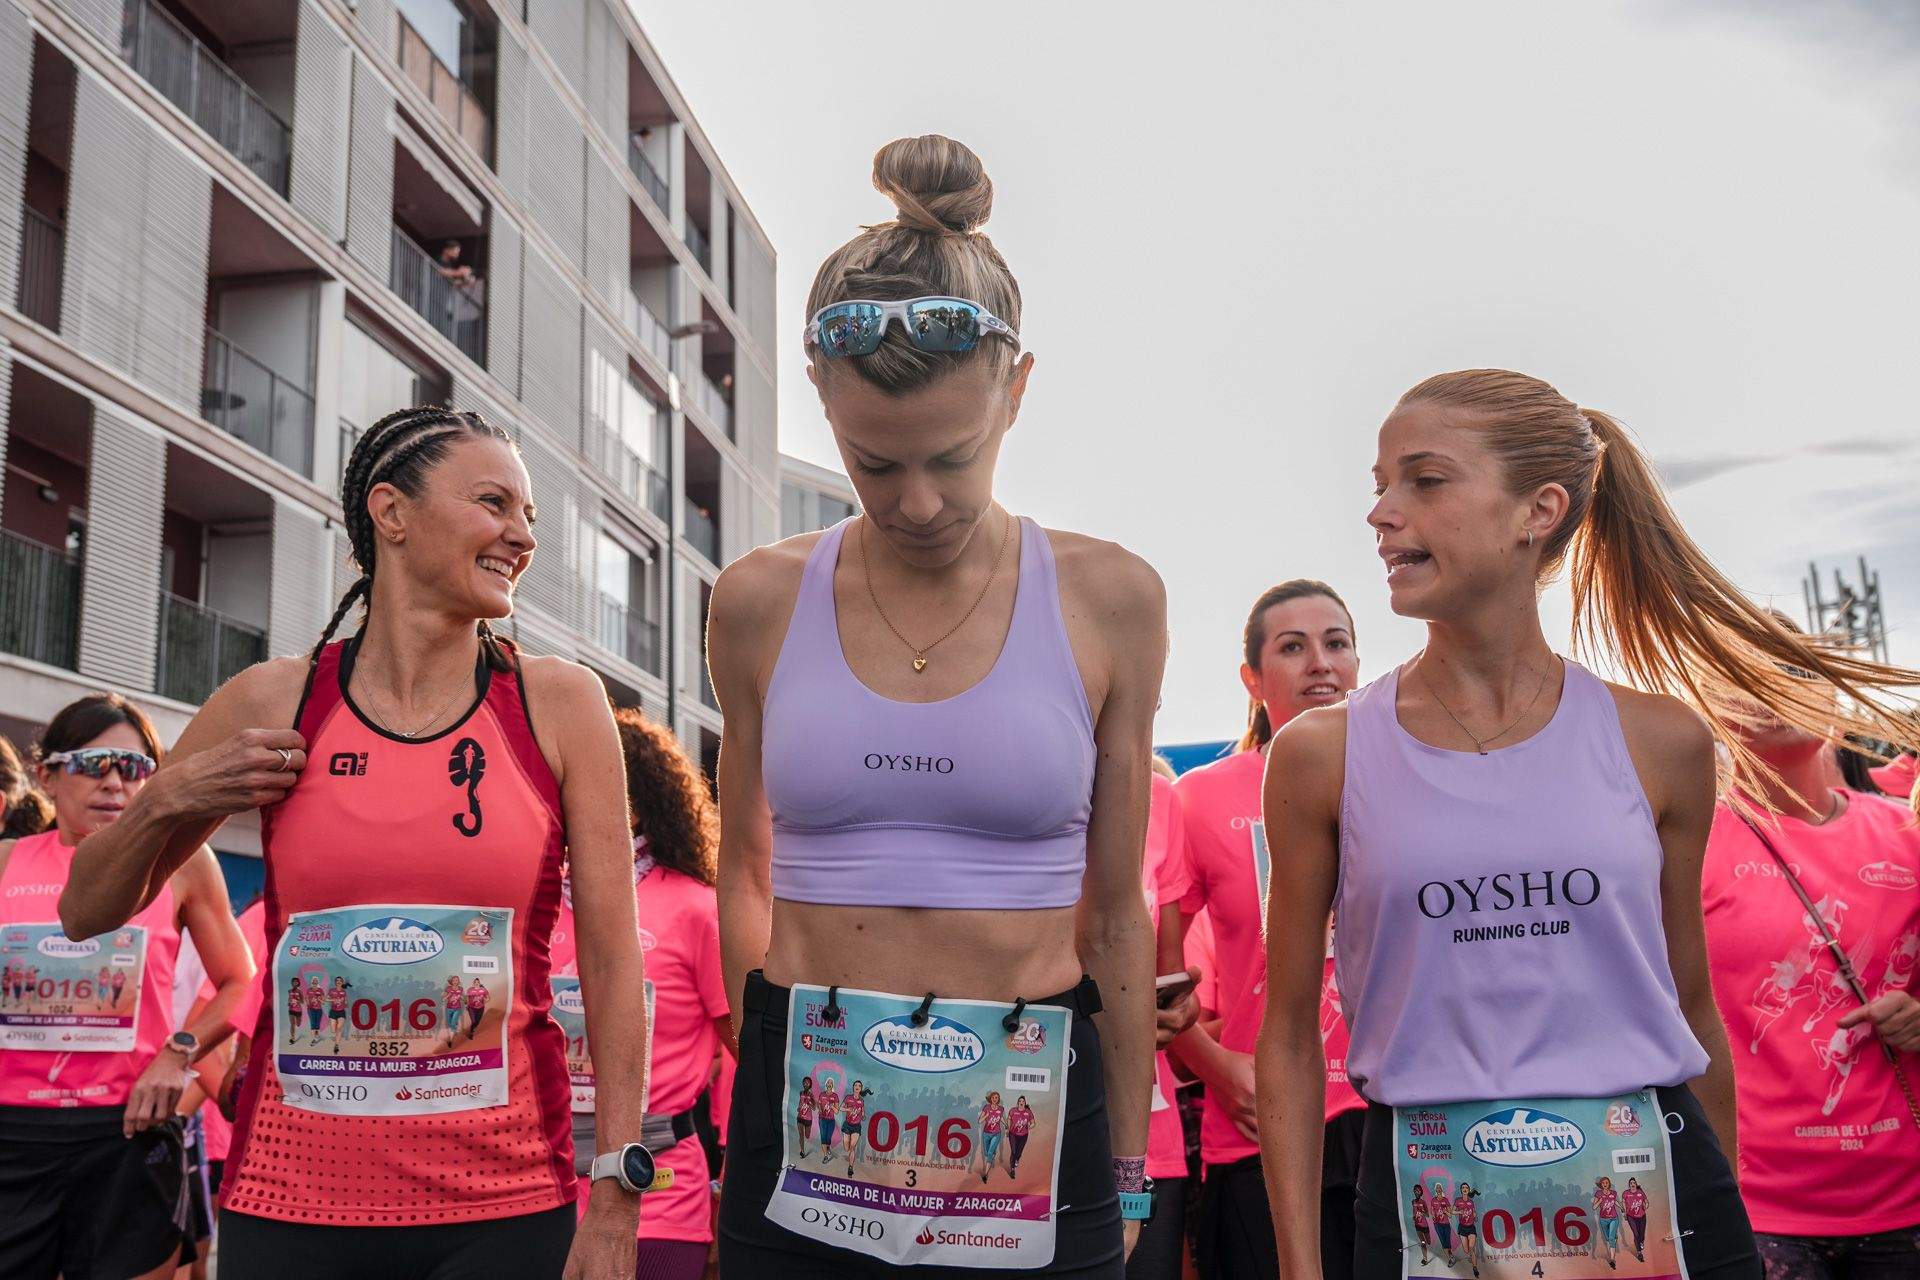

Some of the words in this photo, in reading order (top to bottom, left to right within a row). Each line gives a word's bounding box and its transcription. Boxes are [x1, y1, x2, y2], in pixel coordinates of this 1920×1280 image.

[864, 753, 954, 774] OYSHO
[6, 883, 64, 898] OYSHO
[1417, 868, 1601, 919] OYSHO
[298, 931, 331, 942] SUMA
[1453, 923, 1526, 944] RUNNING
[1530, 920, 1570, 936] CLUB
[350, 934, 438, 953] ASTURIANA
[37, 978, 93, 999] 016
[48, 1003, 74, 1014] 1024
[351, 998, 437, 1031] 016
[816, 1034, 848, 1047] Zaragoza
[889, 1029, 929, 1041] CENTRAL
[932, 1033, 974, 1044] LECHERA
[1014, 1022, 1041, 1041] 20
[368, 1041, 410, 1057] 8352
[815, 1043, 848, 1056] DEPORTE
[870, 1029, 976, 1061] ASTURIANA
[299, 1059, 346, 1072] CARRERA
[348, 1060, 362, 1072] DE
[364, 1060, 377, 1072] LA
[380, 1061, 417, 1073] MUJER
[426, 1055, 482, 1071] ZARAGOZA
[301, 1083, 368, 1101] OYSHO
[415, 1083, 483, 1100] Santander
[867, 1111, 972, 1159] 016
[1410, 1121, 1448, 1136] SUMA
[1486, 1125, 1526, 1135] CENTRAL
[1529, 1124, 1571, 1135] LECHERA
[1794, 1125, 1840, 1138] CARRERA
[1841, 1125, 1856, 1137] DE
[1856, 1124, 1870, 1136] LA
[1421, 1143, 1452, 1153] Zaragoza
[1471, 1130, 1578, 1154] ASTURIANA
[1840, 1139, 1864, 1151] 2024
[1420, 1151, 1453, 1160] DEPORTE
[904, 1169, 918, 1188] 3
[810, 1178, 860, 1200] CARRERA
[864, 1187, 880, 1203] DE
[882, 1191, 897, 1206] LA
[900, 1193, 945, 1210] MUJER
[954, 1197, 1023, 1212] ZARAGOZA
[800, 1207, 885, 1241] OYSHO
[1482, 1206, 1591, 1249] 016
[936, 1229, 1022, 1250] Santander
[1531, 1260, 1545, 1279] 4
